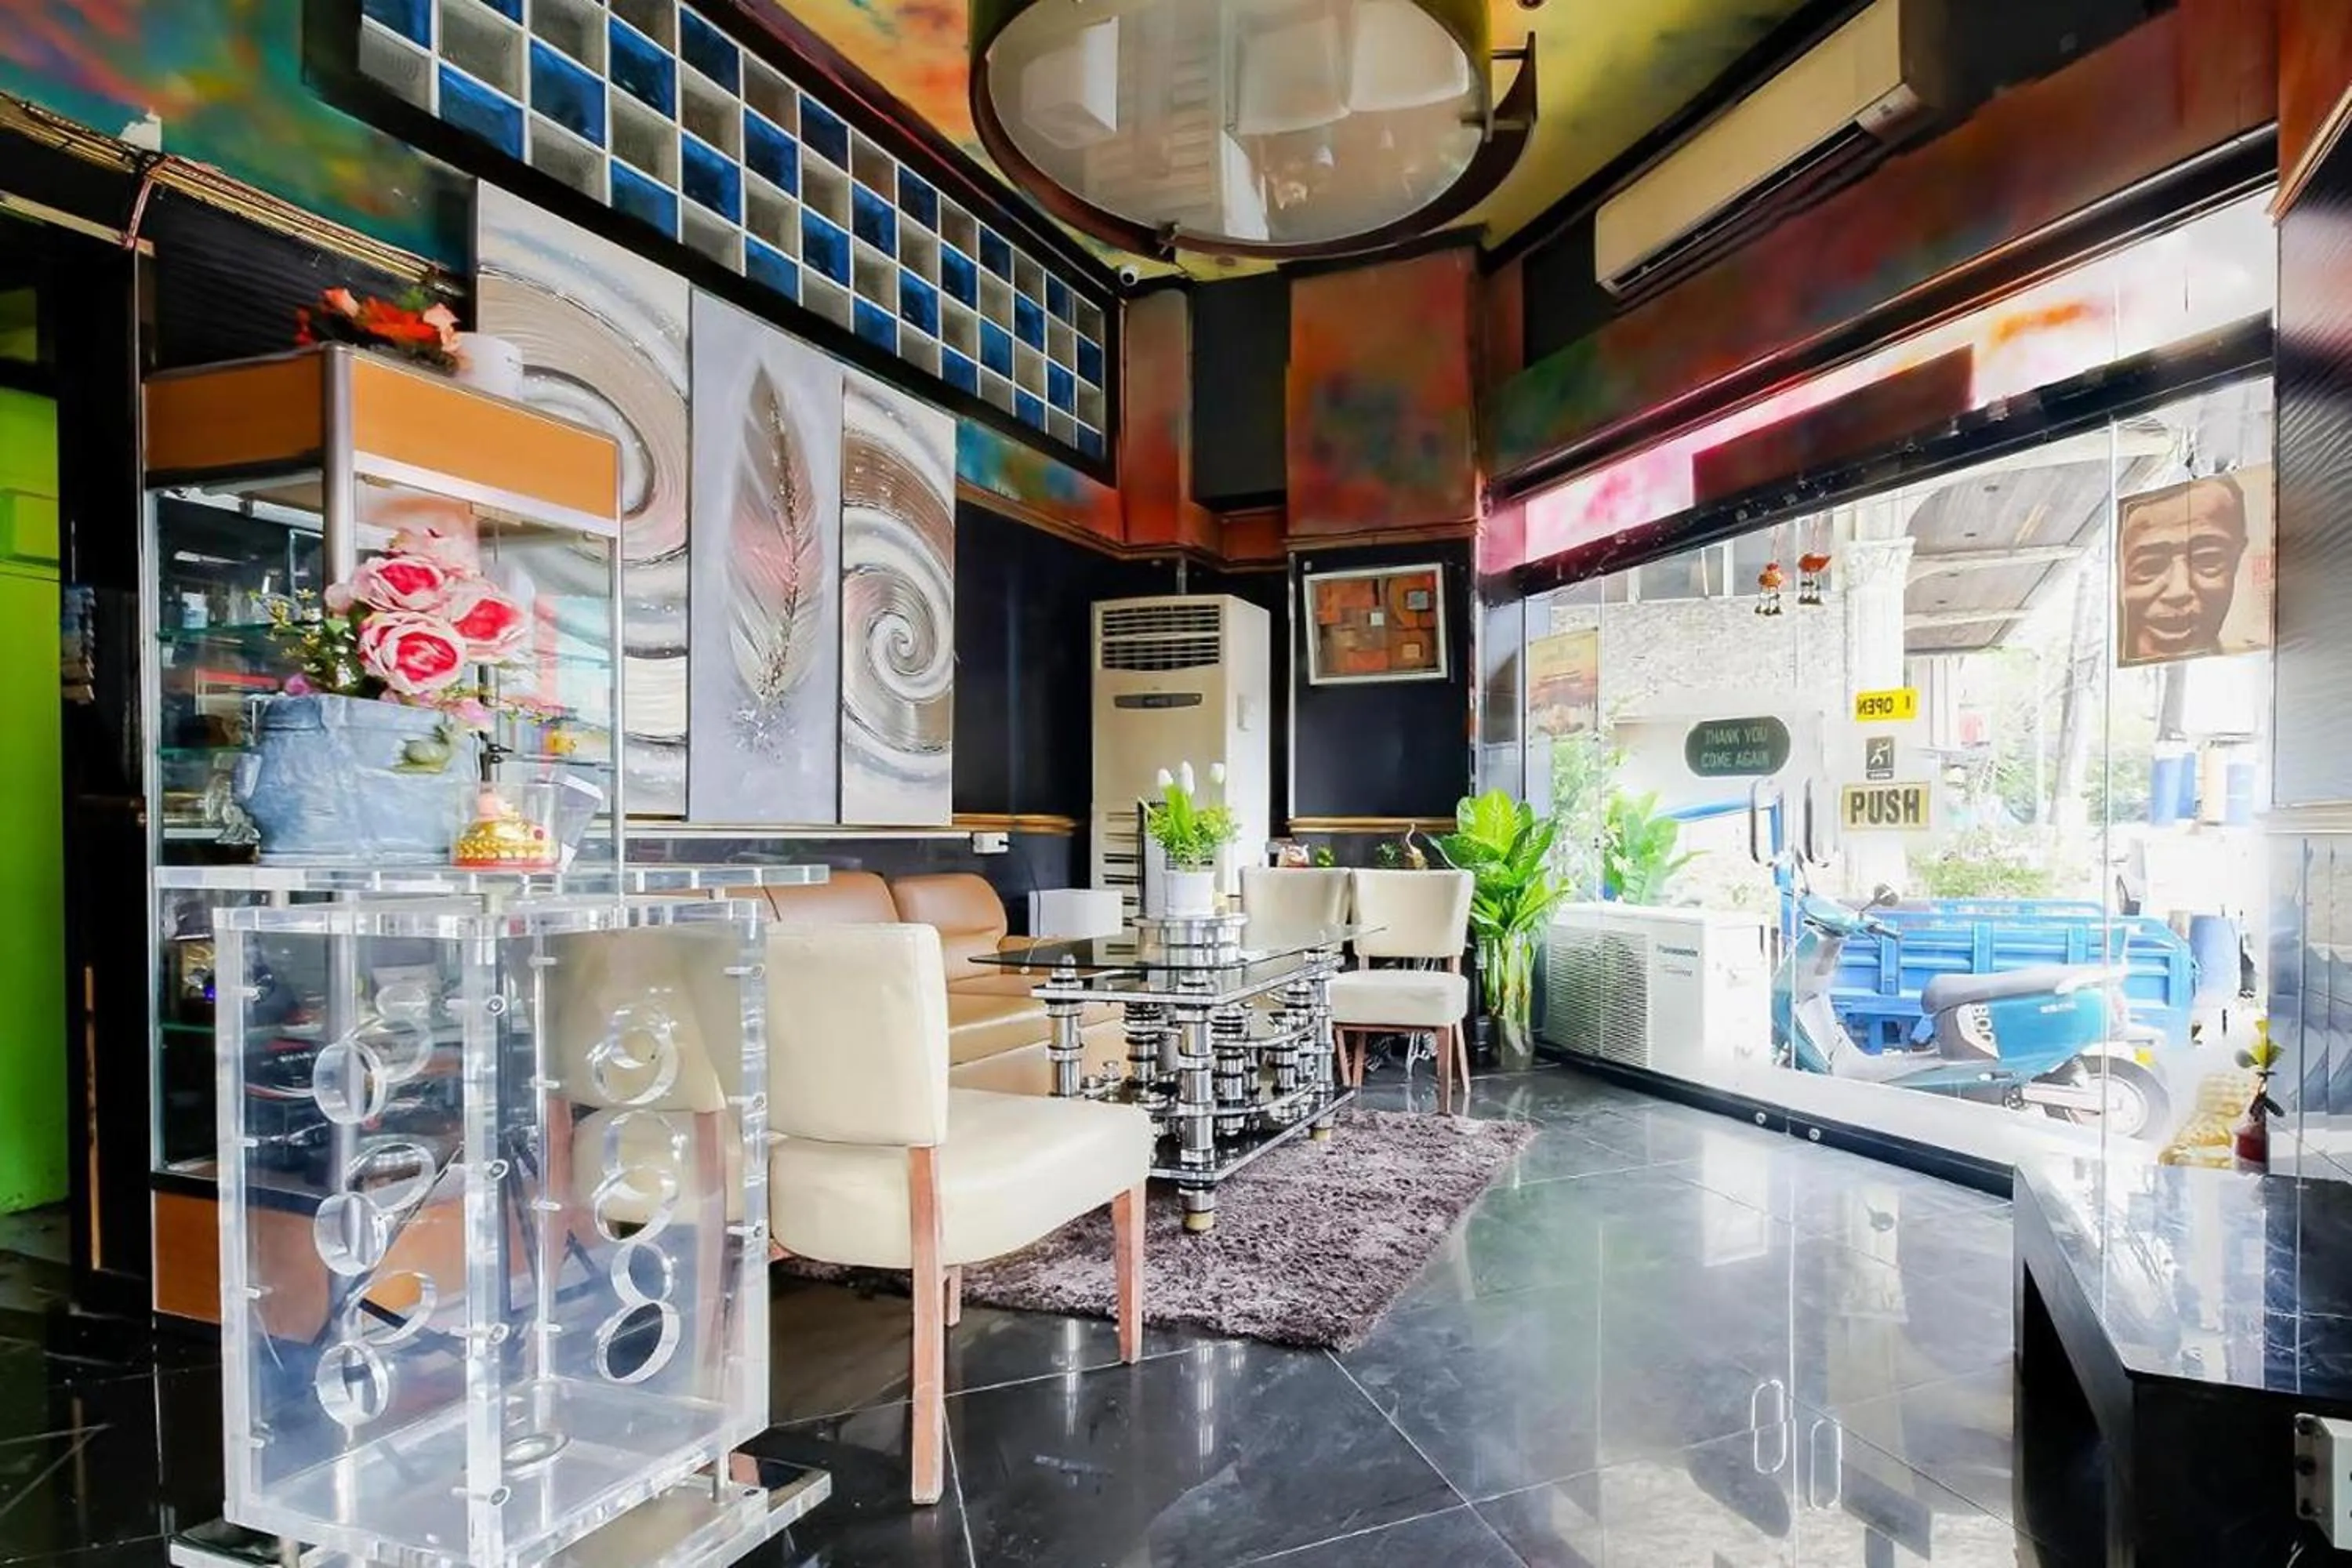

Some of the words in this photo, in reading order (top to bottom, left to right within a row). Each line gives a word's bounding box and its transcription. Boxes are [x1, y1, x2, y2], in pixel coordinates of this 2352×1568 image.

[1704, 728, 1740, 746] THANK
[1744, 726, 1768, 743] YOU
[1700, 752, 1732, 768] COME
[1735, 750, 1769, 768] AGAIN
[1849, 789, 1920, 824] PUSH
